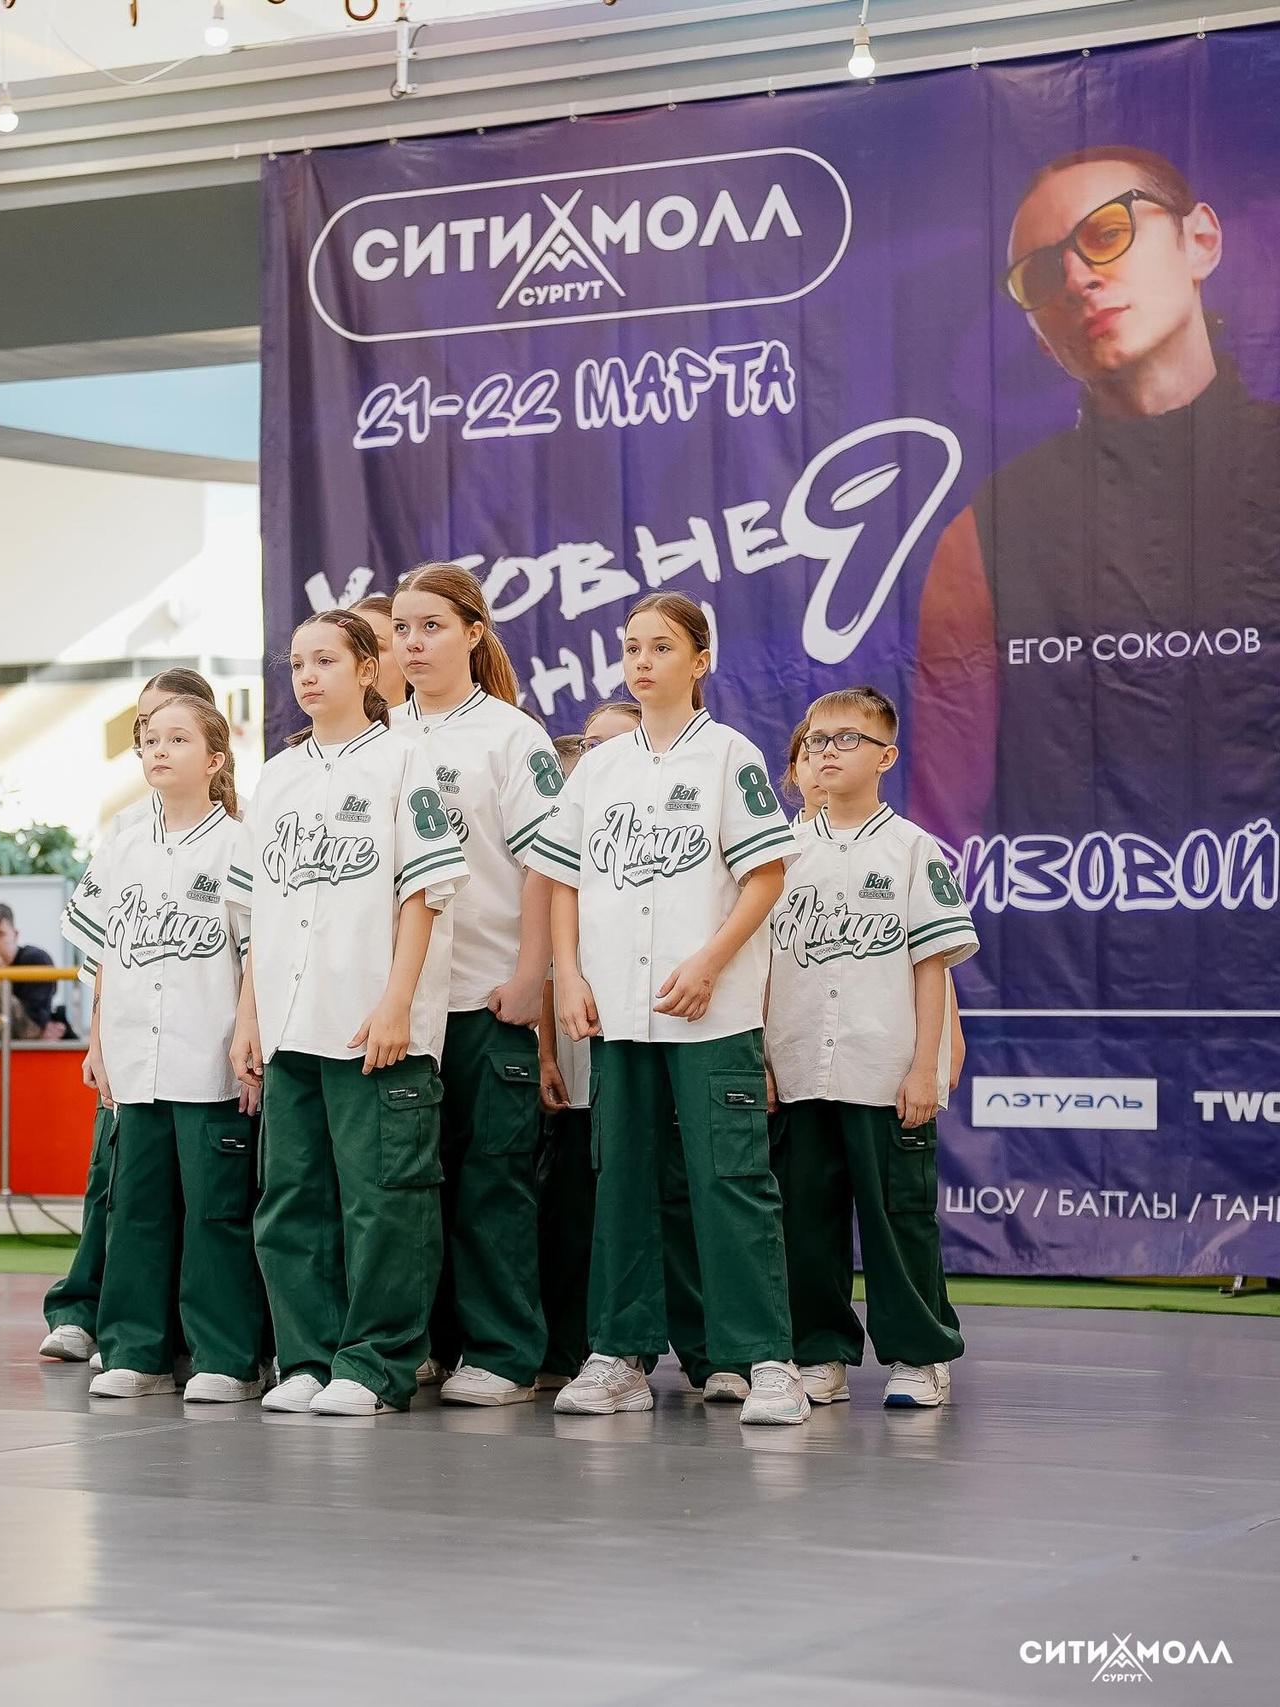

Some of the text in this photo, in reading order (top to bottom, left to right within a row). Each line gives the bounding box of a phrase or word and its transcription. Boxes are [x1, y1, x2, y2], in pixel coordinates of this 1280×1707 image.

[352, 184, 802, 282] СИТИ МОЛЛ
[518, 280, 604, 306] СУРГУТ
[353, 340, 796, 449] 21-22 МАРТА
[1008, 627, 1262, 665] ЕГОР СОКОЛОВ
[342, 795, 370, 812] Bak
[670, 784, 699, 801] Bak
[192, 874, 221, 894] Bak
[864, 872, 893, 890] Bak
[945, 1185, 1024, 1214] ШОУ
[1057, 1189, 1176, 1220] БАТТЛЫ
[1211, 1193, 1280, 1222] ТАН
